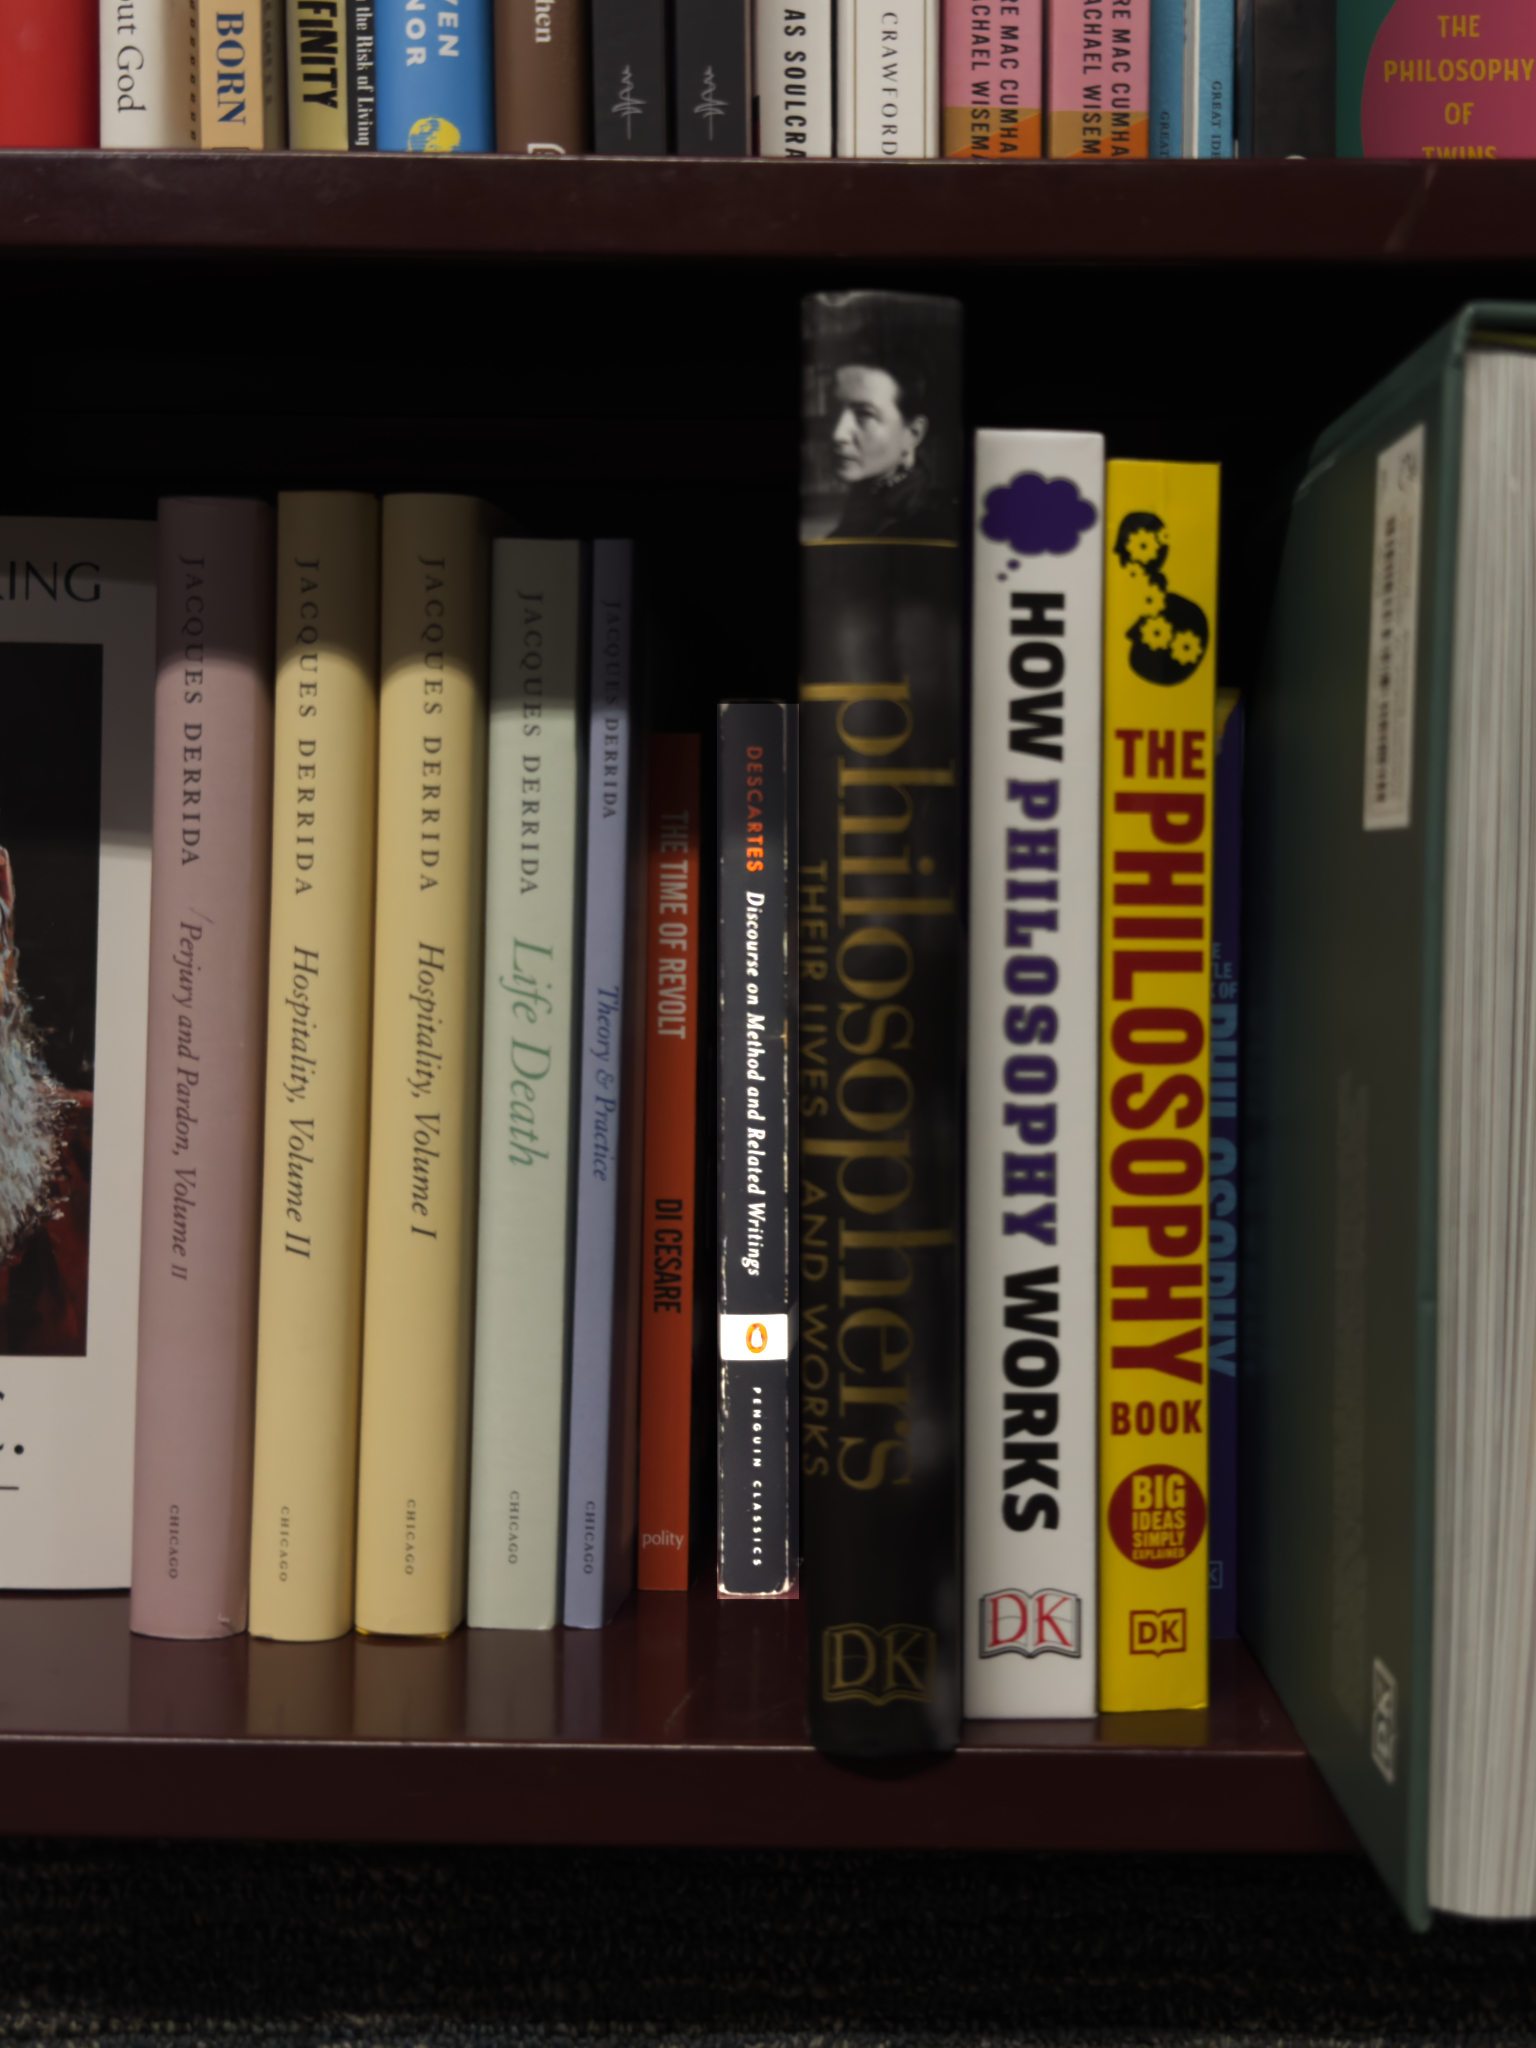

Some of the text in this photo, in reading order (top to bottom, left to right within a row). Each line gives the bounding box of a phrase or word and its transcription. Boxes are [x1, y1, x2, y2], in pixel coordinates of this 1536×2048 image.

[356, 6, 373, 31] the
[437, 0, 460, 57] EN
[535, 0, 552, 43] hen
[784, 9, 806, 38] AS
[971, 0, 991, 71] CHAEL
[999, 25, 1019, 70] MAC
[1111, 29, 1131, 74] MAC
[1437, 14, 1481, 38] THE
[117, 0, 147, 114] ut God
[216, 11, 247, 125] BORN
[297, 0, 338, 109] FINITY
[356, 35, 374, 71] Risk
[357, 75, 374, 92] of
[880, 11, 898, 157] CRAWFORD
[1384, 58, 1535, 83] PHILOSOPHY
[354, 97, 374, 146] Living
[999, 79, 1019, 154] CUMHA
[1082, 84, 1102, 155] WISEM
[1111, 83, 1131, 157] CUMHA
[1160, 111, 1170, 158] GREAT
[1211, 81, 1222, 128] GREAT
[1444, 102, 1475, 125] OF
[1422, 145, 1498, 160] TWINS
[0, 561, 101, 603] ING
[1115, 729, 1207, 780] THE
[283, 557, 320, 1259] JACQUES DERRIDA Hospitality, Volume II
[406, 554, 445, 1240] JACQUES DERRIDA Hospitality, Volume I
[499, 588, 554, 1168] JACQUES DERRIDA Life Death
[590, 600, 622, 1183] JACQUES DERRIDA Theory & Practice
[170, 553, 205, 1281] JACQUES DERRIDA Perjury and Pardon, Volume II
[740, 745, 767, 1277] DESCARTES Discourse on Method and Related Writings
[653, 810, 689, 1314] THE TIME OF REVOLT DI CESARE
[800, 675, 956, 1490] philosophers
[1001, 591, 1067, 1533] HOW PHILOSOPHY WORKS
[1109, 791, 1207, 1386] PHILOSOPHY
[799, 859, 830, 1477] THEIR LIVES AND WORKS
[1110, 1398, 1203, 1436] BOOK
[752, 1386, 762, 1566] PENGUIN CLASSICS
[1132, 1473, 1187, 1510] BIG
[168, 1504, 180, 1580] CHICAGO
[279, 1505, 291, 1582] CHICAGO
[404, 1499, 416, 1576] CHICAGO
[507, 1490, 520, 1566] CHICAGO
[582, 1500, 596, 1576] CHICAGO
[641, 1530, 684, 1551] polity
[1132, 1510, 1187, 1531] IDEAS
[1132, 1530, 1187, 1548] SIMPLY
[1132, 1547, 1187, 1561] EXPLAINED
[986, 1593, 1074, 1649] DK
[1137, 1618, 1180, 1646] DK
[831, 1627, 926, 1693] DK
